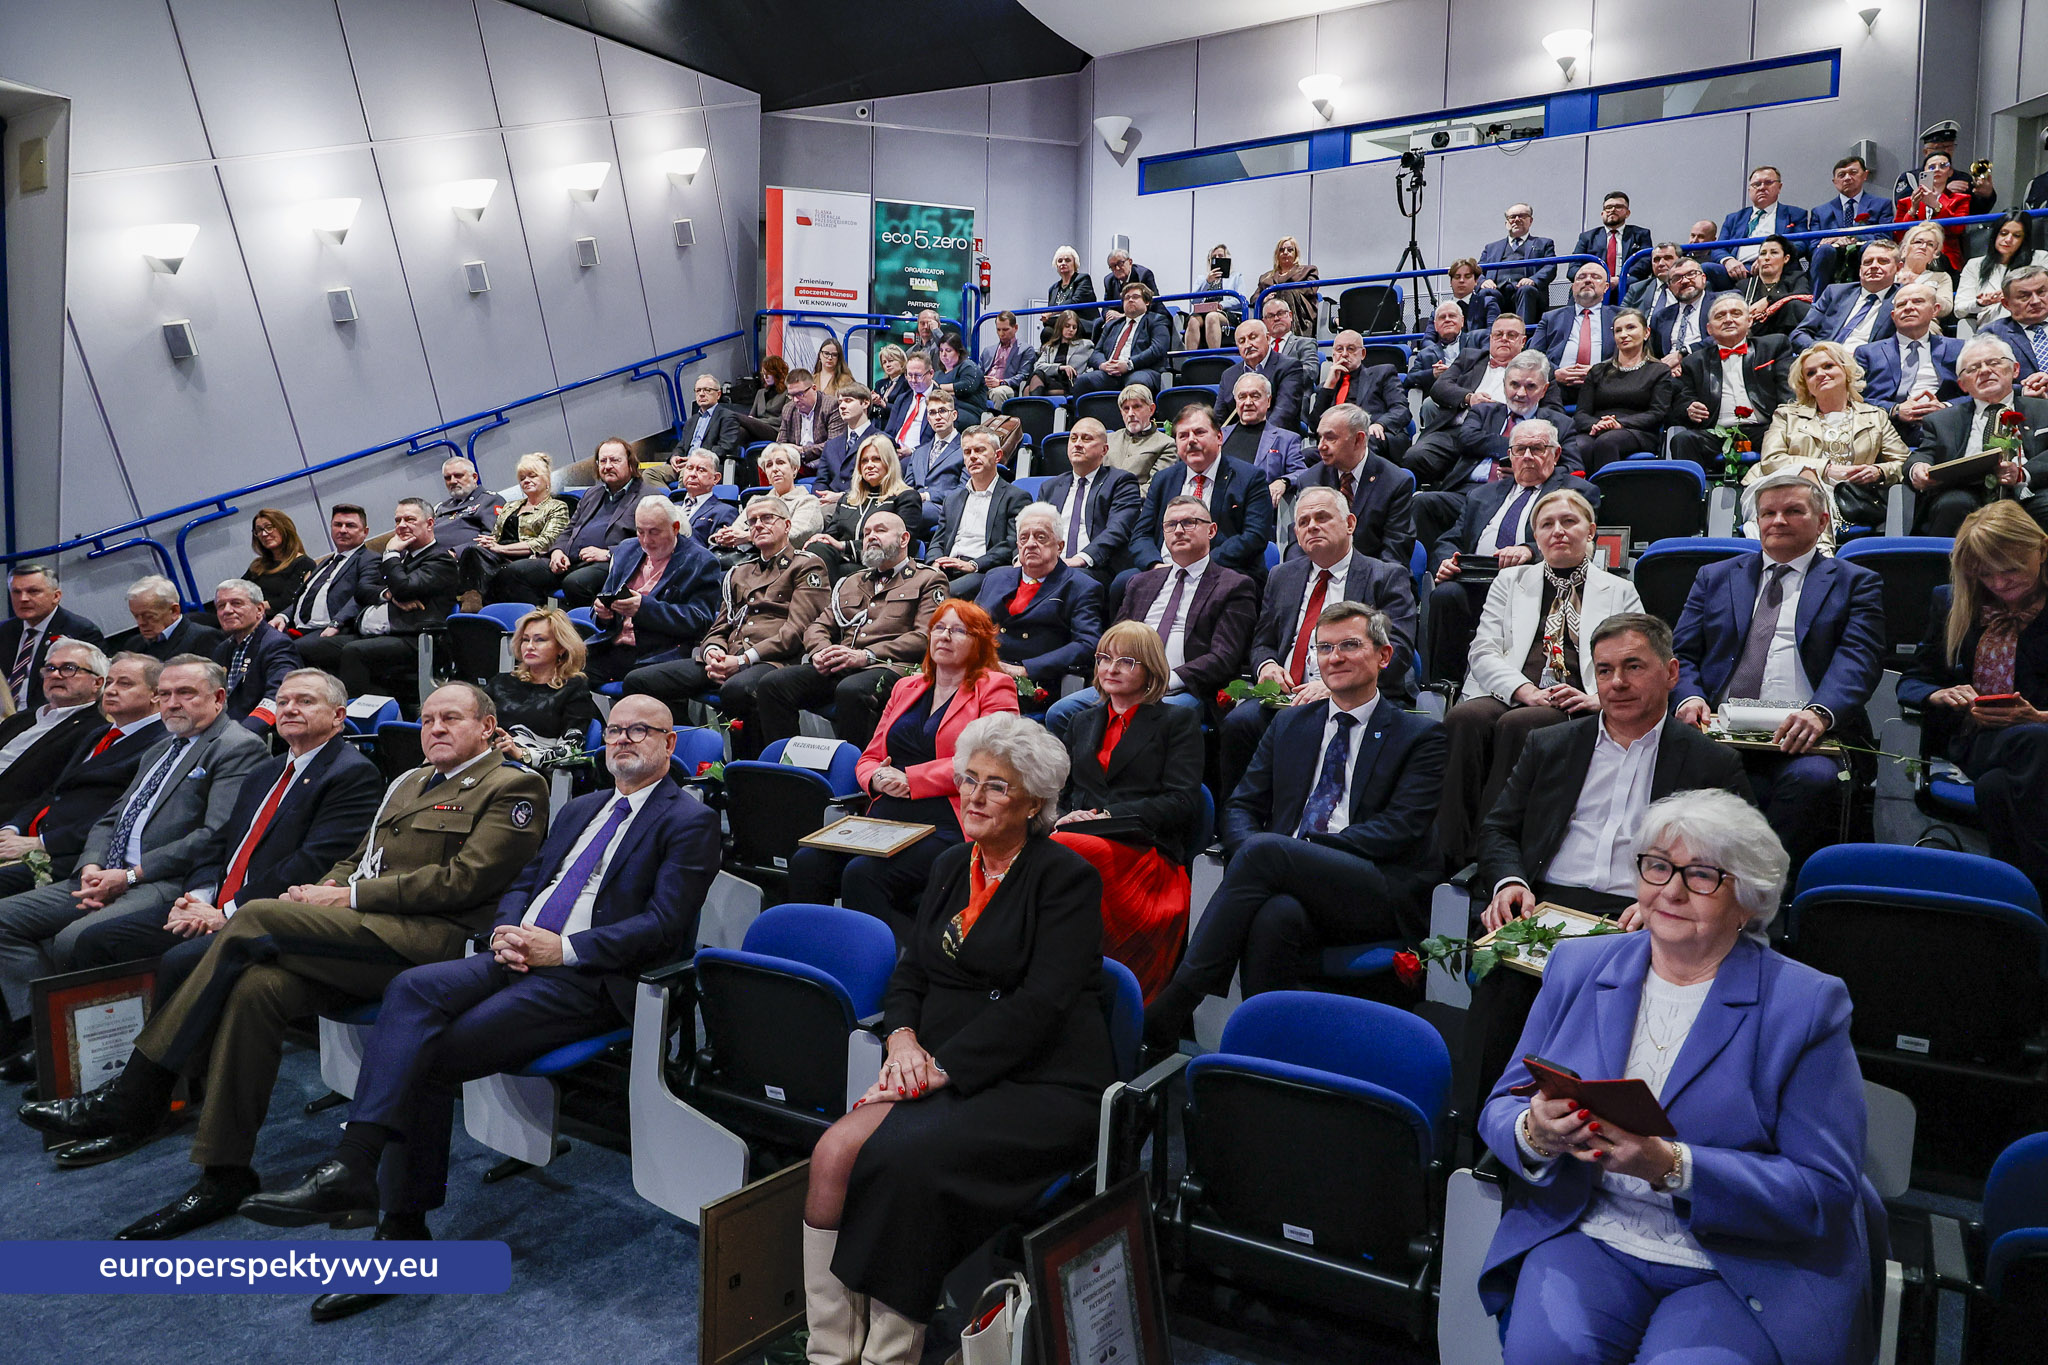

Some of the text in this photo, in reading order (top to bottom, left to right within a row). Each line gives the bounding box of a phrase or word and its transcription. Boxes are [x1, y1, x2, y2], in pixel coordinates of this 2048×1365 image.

[881, 231, 912, 245] eco
[904, 266, 945, 275] ORGANIZATOR
[799, 278, 834, 286] Zmieniamy
[830, 290, 854, 298] biznesu
[907, 300, 940, 309] PARTNERZY
[792, 742, 830, 751] REZERWACJA
